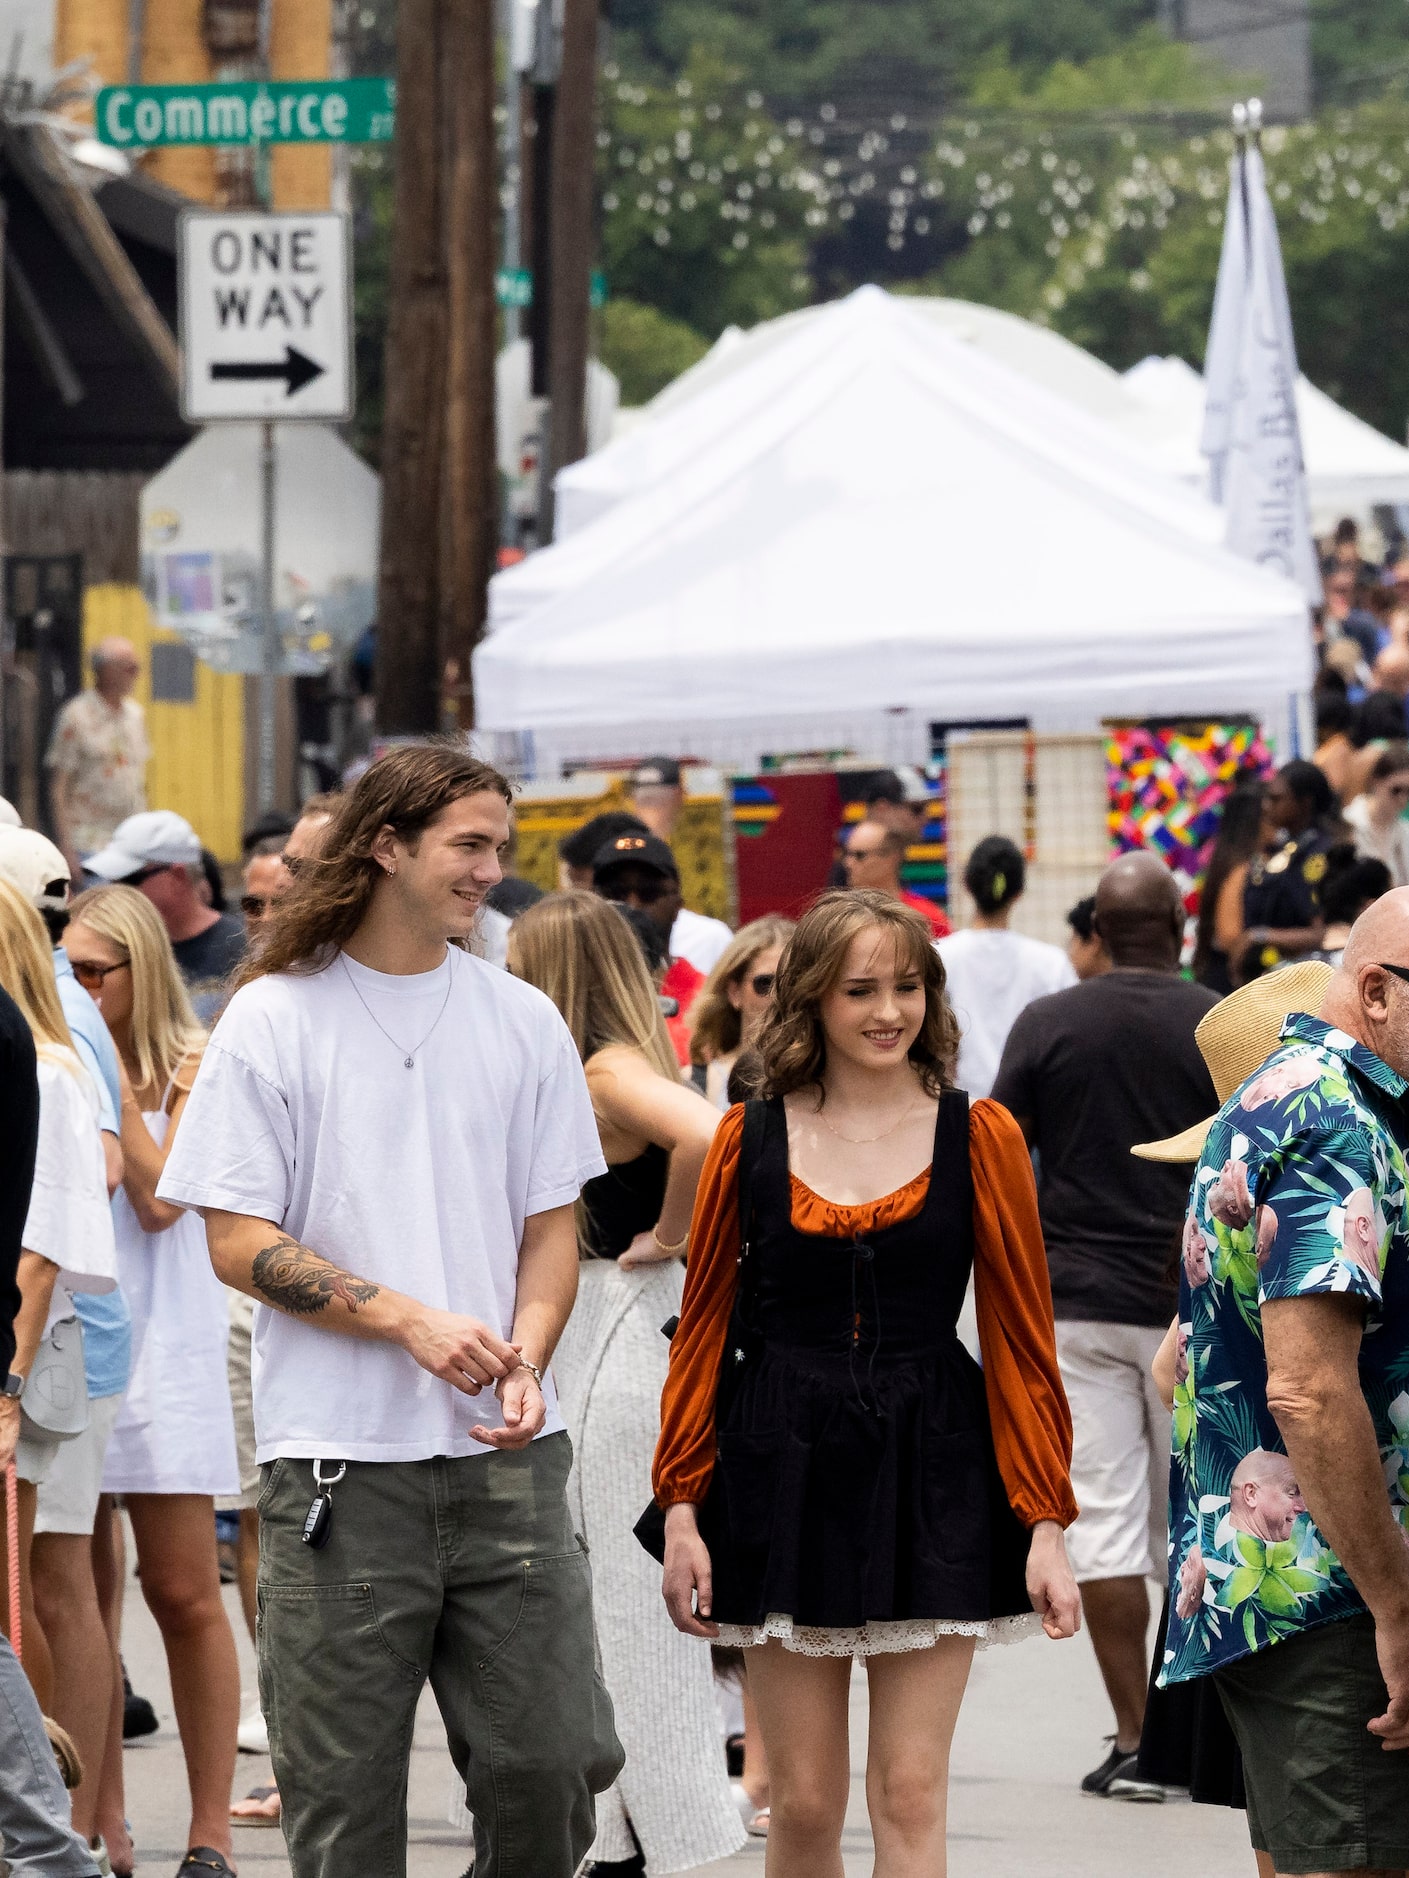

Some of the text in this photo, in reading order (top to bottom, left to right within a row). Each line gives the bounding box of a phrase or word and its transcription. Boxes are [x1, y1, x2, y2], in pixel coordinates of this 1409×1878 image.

[104, 91, 348, 142] Commerce
[210, 229, 319, 275] ONE
[213, 284, 324, 329] WAY
